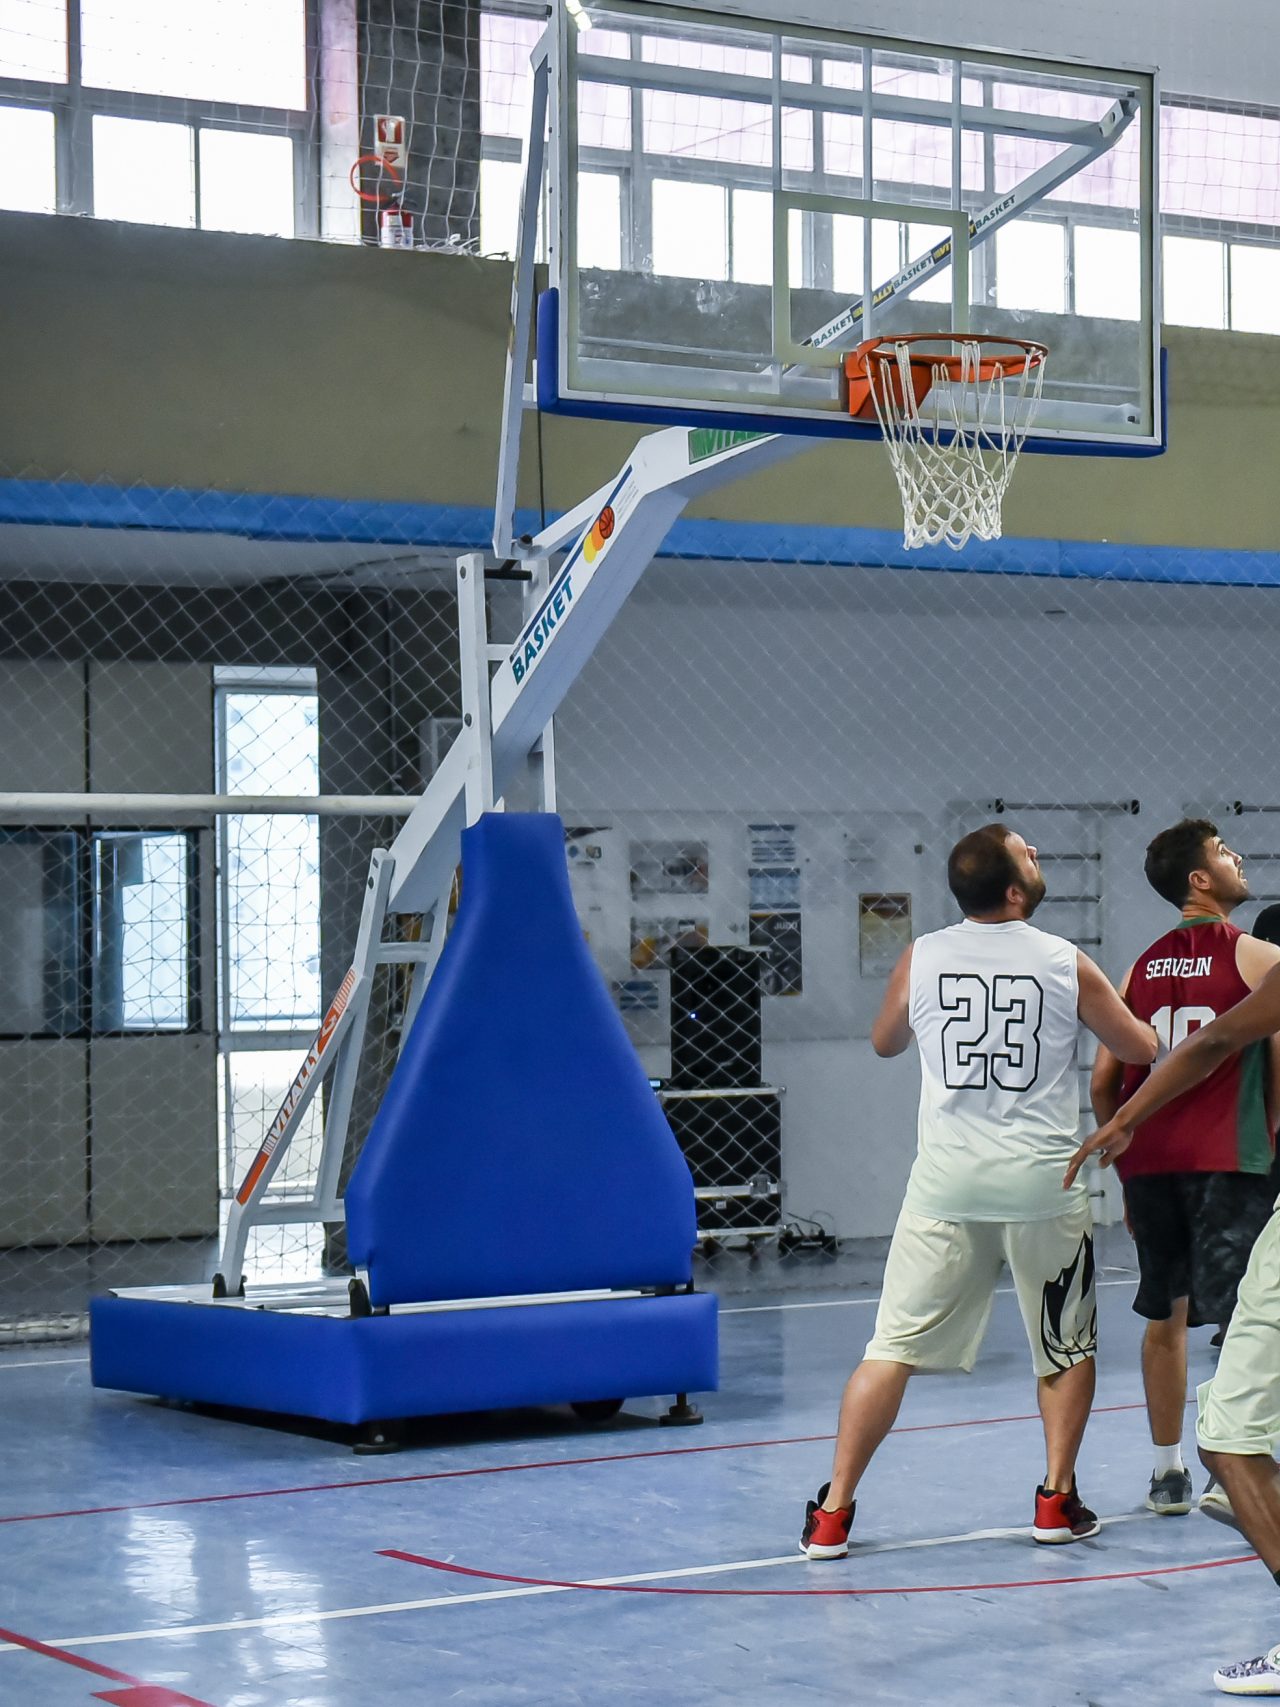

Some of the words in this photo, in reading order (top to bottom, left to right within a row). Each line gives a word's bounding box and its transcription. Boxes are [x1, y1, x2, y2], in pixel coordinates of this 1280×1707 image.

[813, 314, 852, 347] BASKET
[893, 255, 933, 289] BASKET
[975, 194, 1016, 229] BASKET
[512, 575, 574, 685] BASKET
[1145, 956, 1213, 981] SERVELIN
[938, 973, 1044, 1093] 23
[272, 1038, 323, 1140] VITALLY
